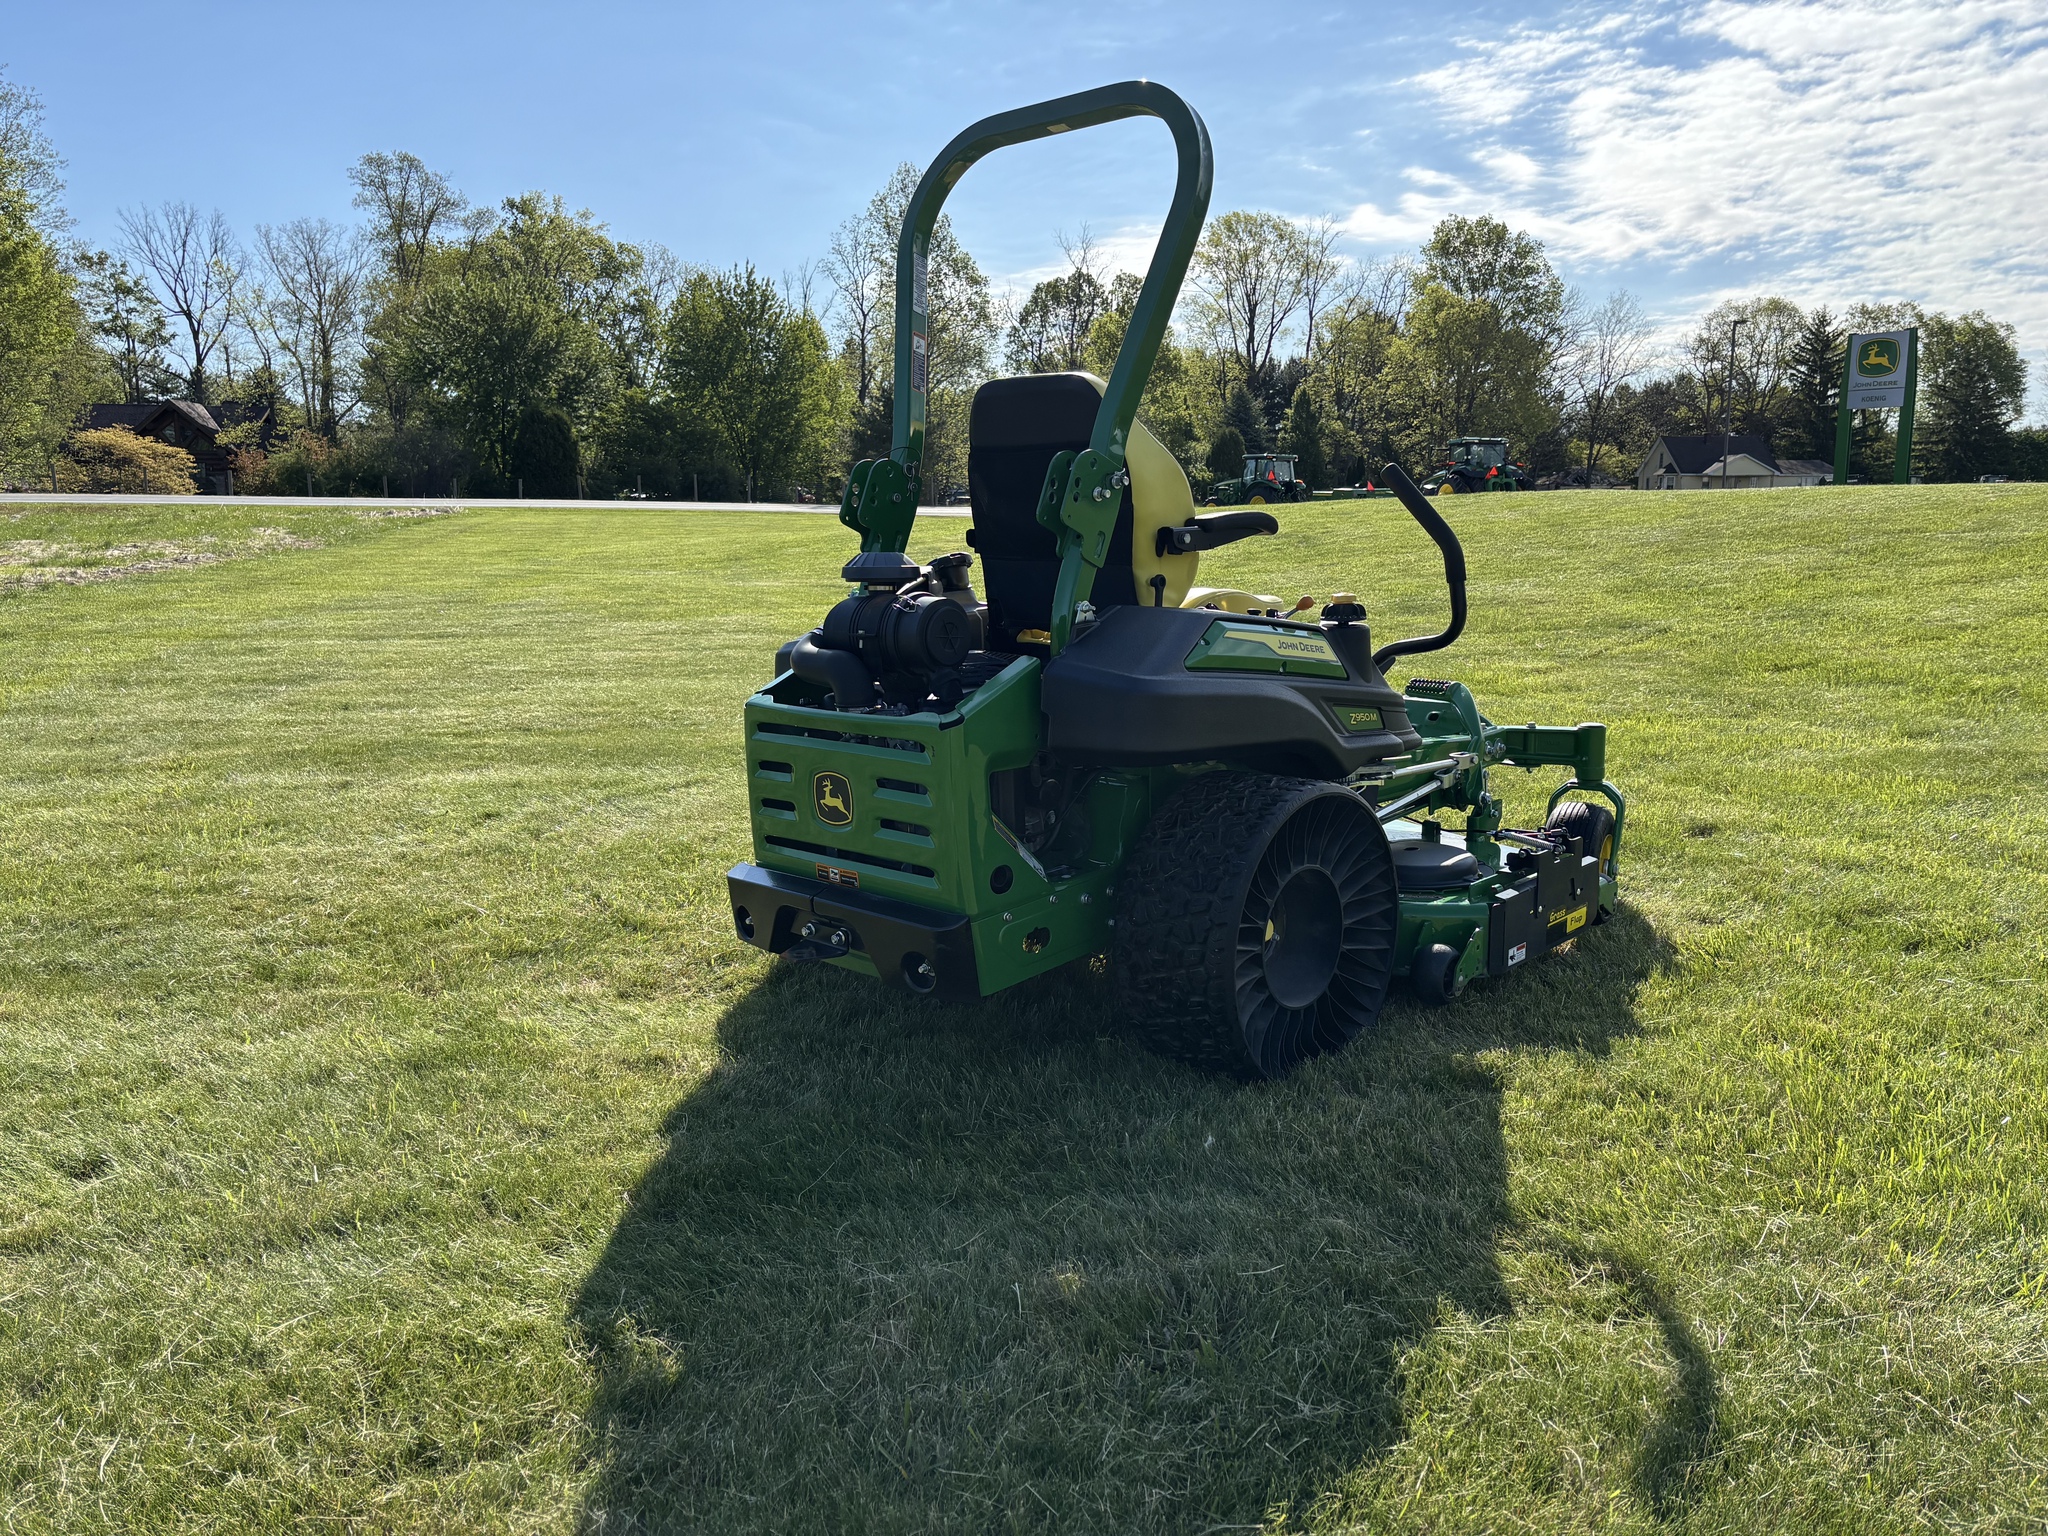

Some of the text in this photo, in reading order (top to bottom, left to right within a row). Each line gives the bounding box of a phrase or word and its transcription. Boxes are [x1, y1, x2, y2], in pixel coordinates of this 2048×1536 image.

[1278, 640, 1326, 654] JOHN DEERE
[1349, 713, 1378, 725] Z950M
[1549, 908, 1583, 926] Grass Flap
